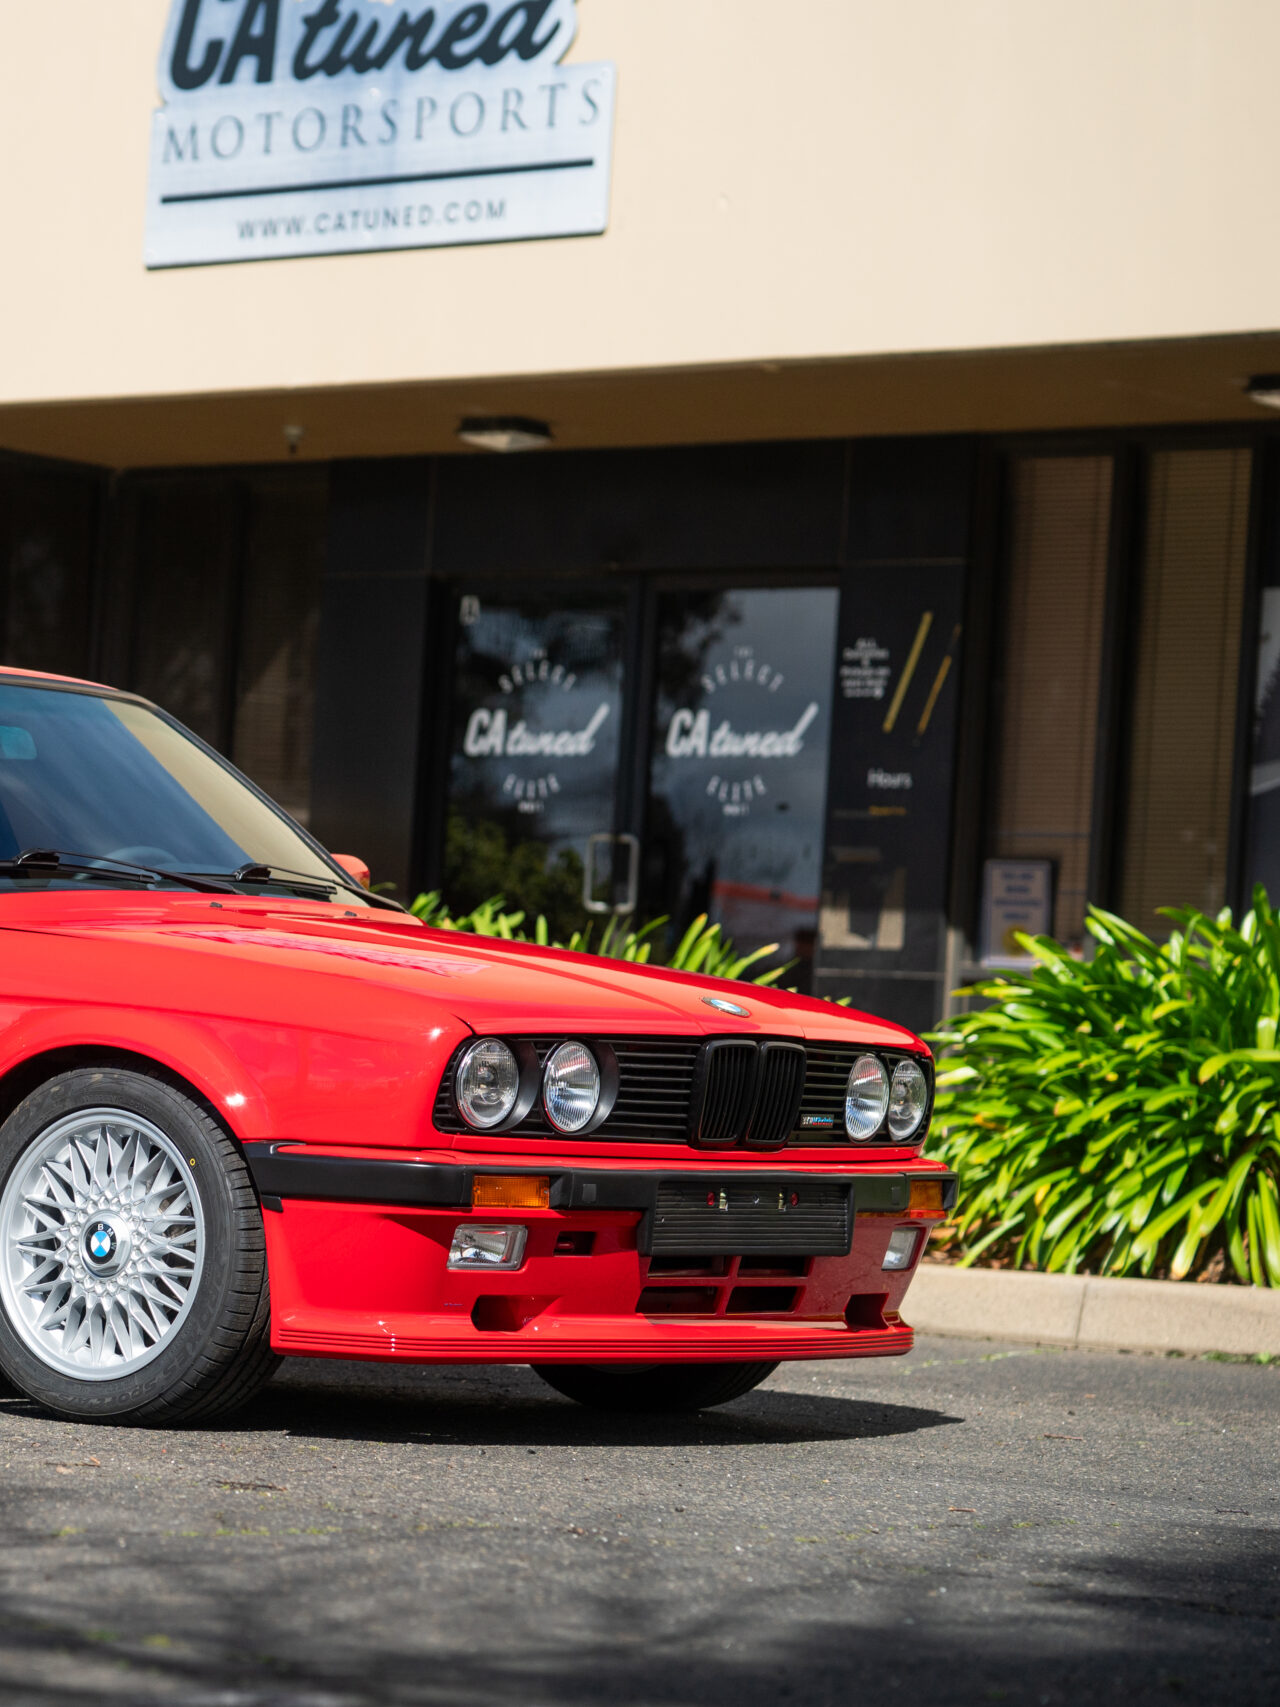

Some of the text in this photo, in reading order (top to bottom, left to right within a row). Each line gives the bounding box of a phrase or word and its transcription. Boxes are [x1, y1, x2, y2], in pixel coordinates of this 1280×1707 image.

[162, 79, 602, 164] MOTORSPORTS
[237, 200, 506, 239] WWW.CATUNED.COM
[867, 769, 912, 789] Hours
